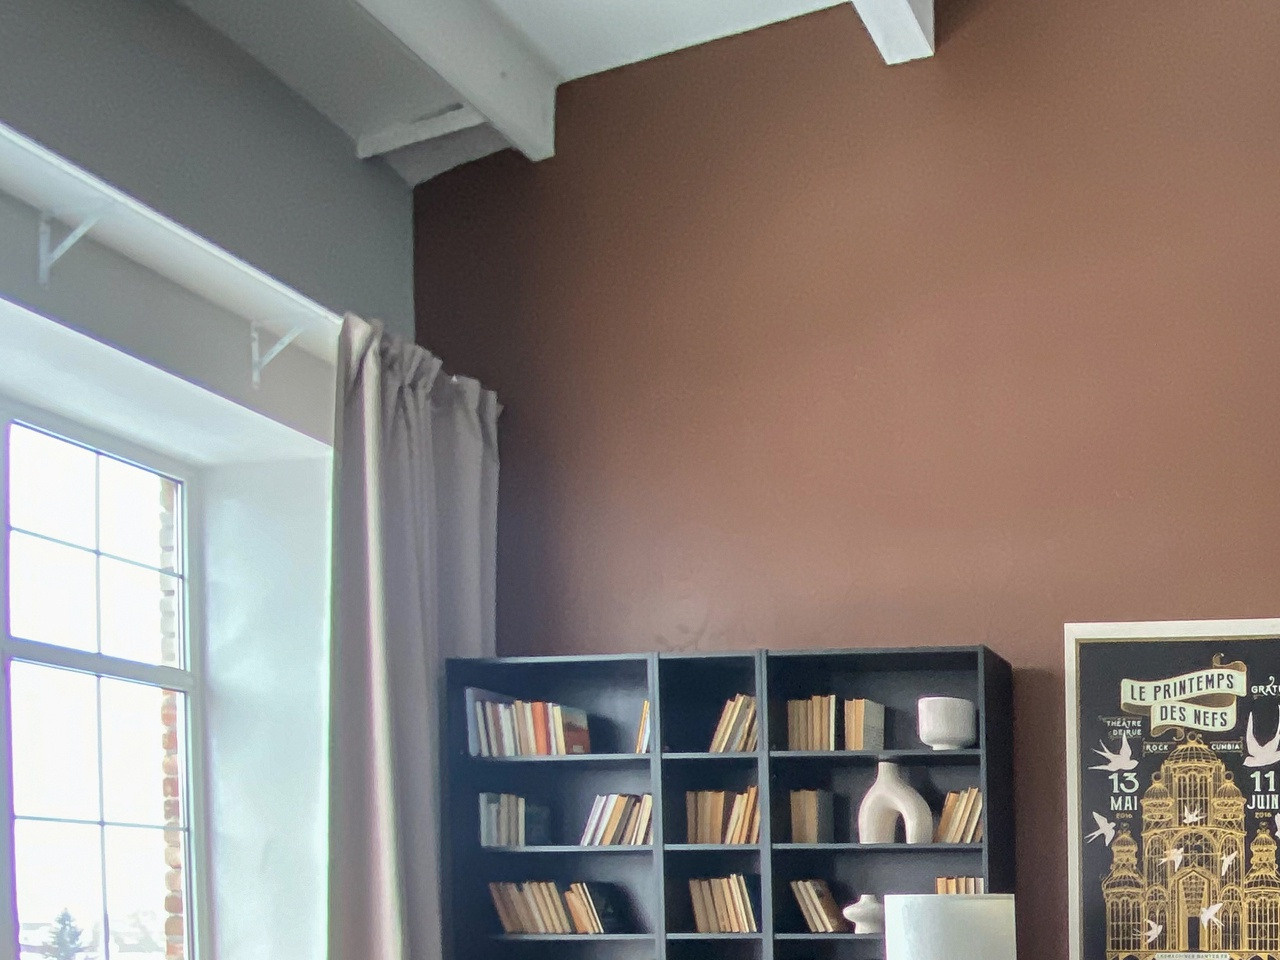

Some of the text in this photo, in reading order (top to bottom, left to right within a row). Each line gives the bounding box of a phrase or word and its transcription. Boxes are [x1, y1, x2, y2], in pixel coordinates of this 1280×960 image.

[1130, 673, 1234, 701] LE PRINTEMPS
[1160, 705, 1228, 727] DES NEFS
[1126, 729, 1142, 739] RUE
[1146, 744, 1169, 752] ROCK
[1108, 772, 1140, 793] 13
[1250, 770, 1276, 792] 11
[1110, 796, 1138, 810] MAI
[1247, 794, 1279, 810] JUIN
